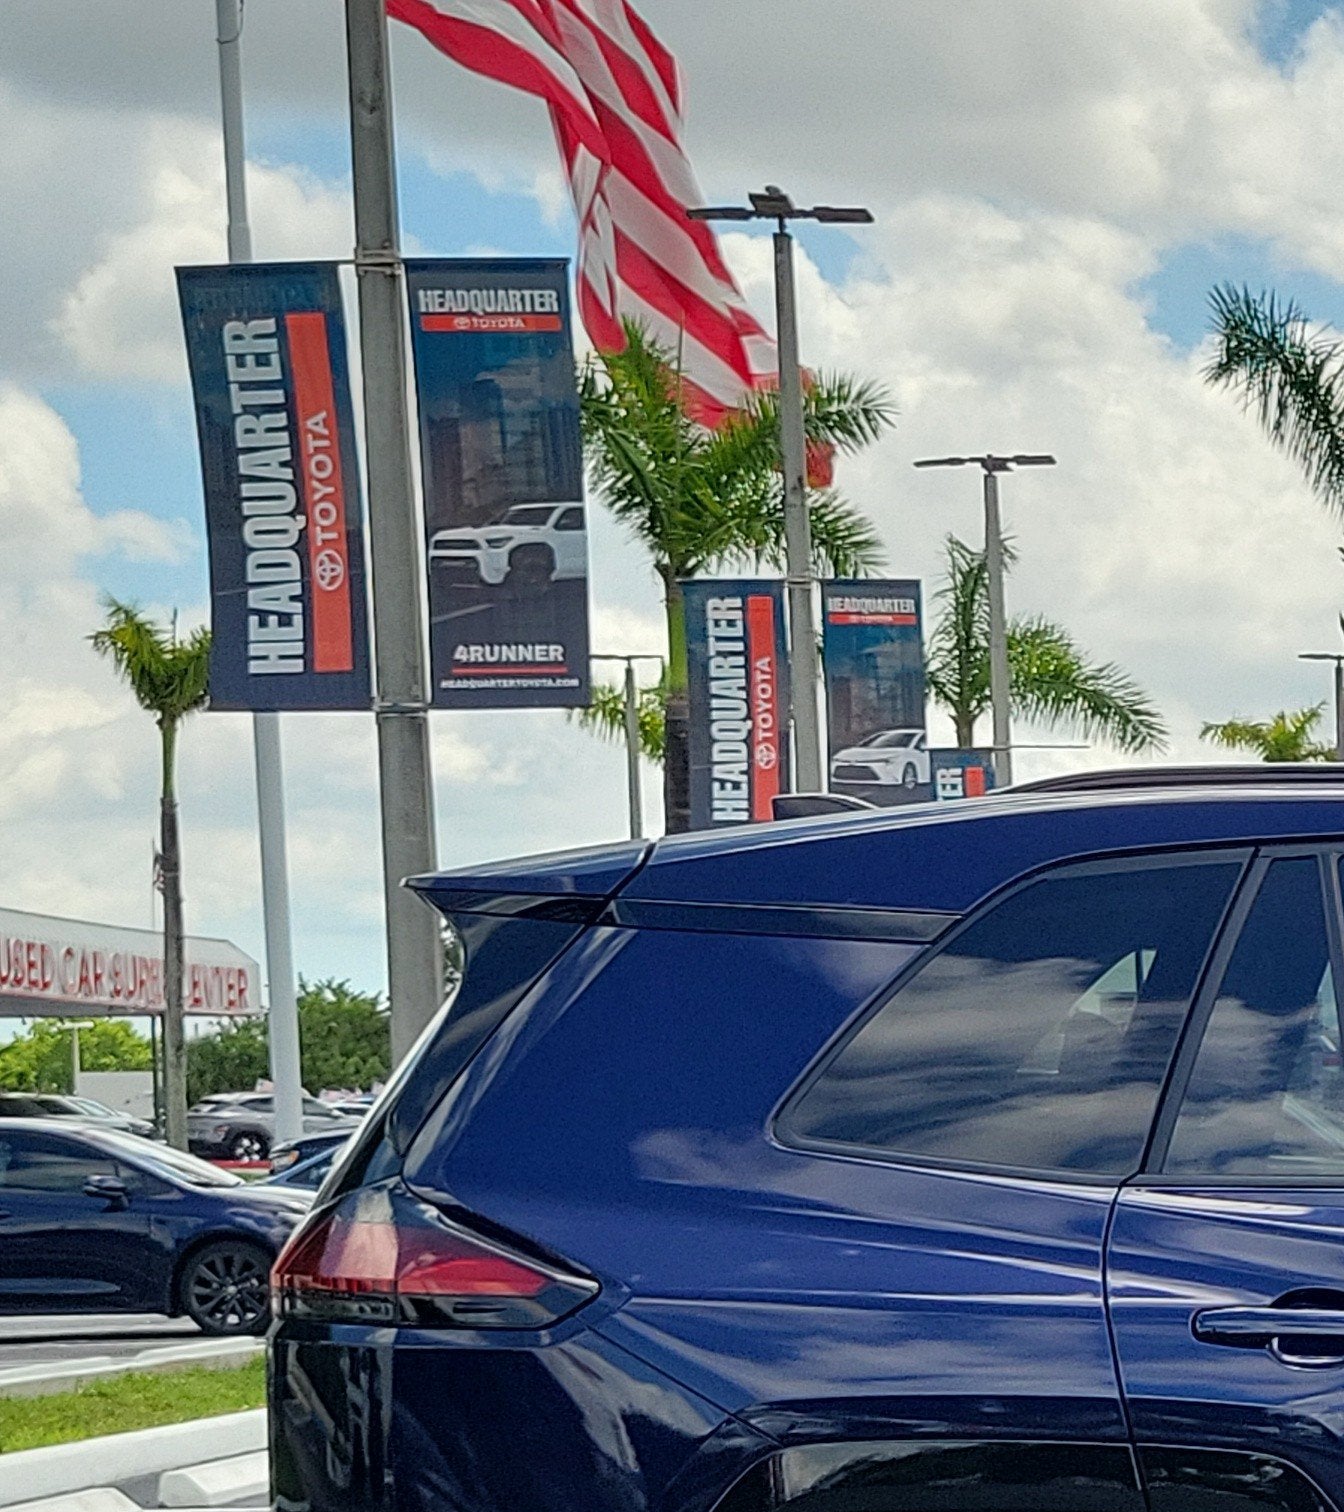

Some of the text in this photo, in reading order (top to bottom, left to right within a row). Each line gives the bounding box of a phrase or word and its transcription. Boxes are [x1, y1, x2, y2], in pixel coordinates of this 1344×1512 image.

[418, 289, 559, 315] HEADQUARTER
[472, 317, 526, 328] TOYOTA
[222, 316, 306, 675] HEADQUARTER
[305, 410, 339, 546] TOYOTA
[453, 643, 565, 663] 4RUNNER
[706, 596, 753, 822] HEADQUARTER
[754, 657, 773, 741] TOYOTA
